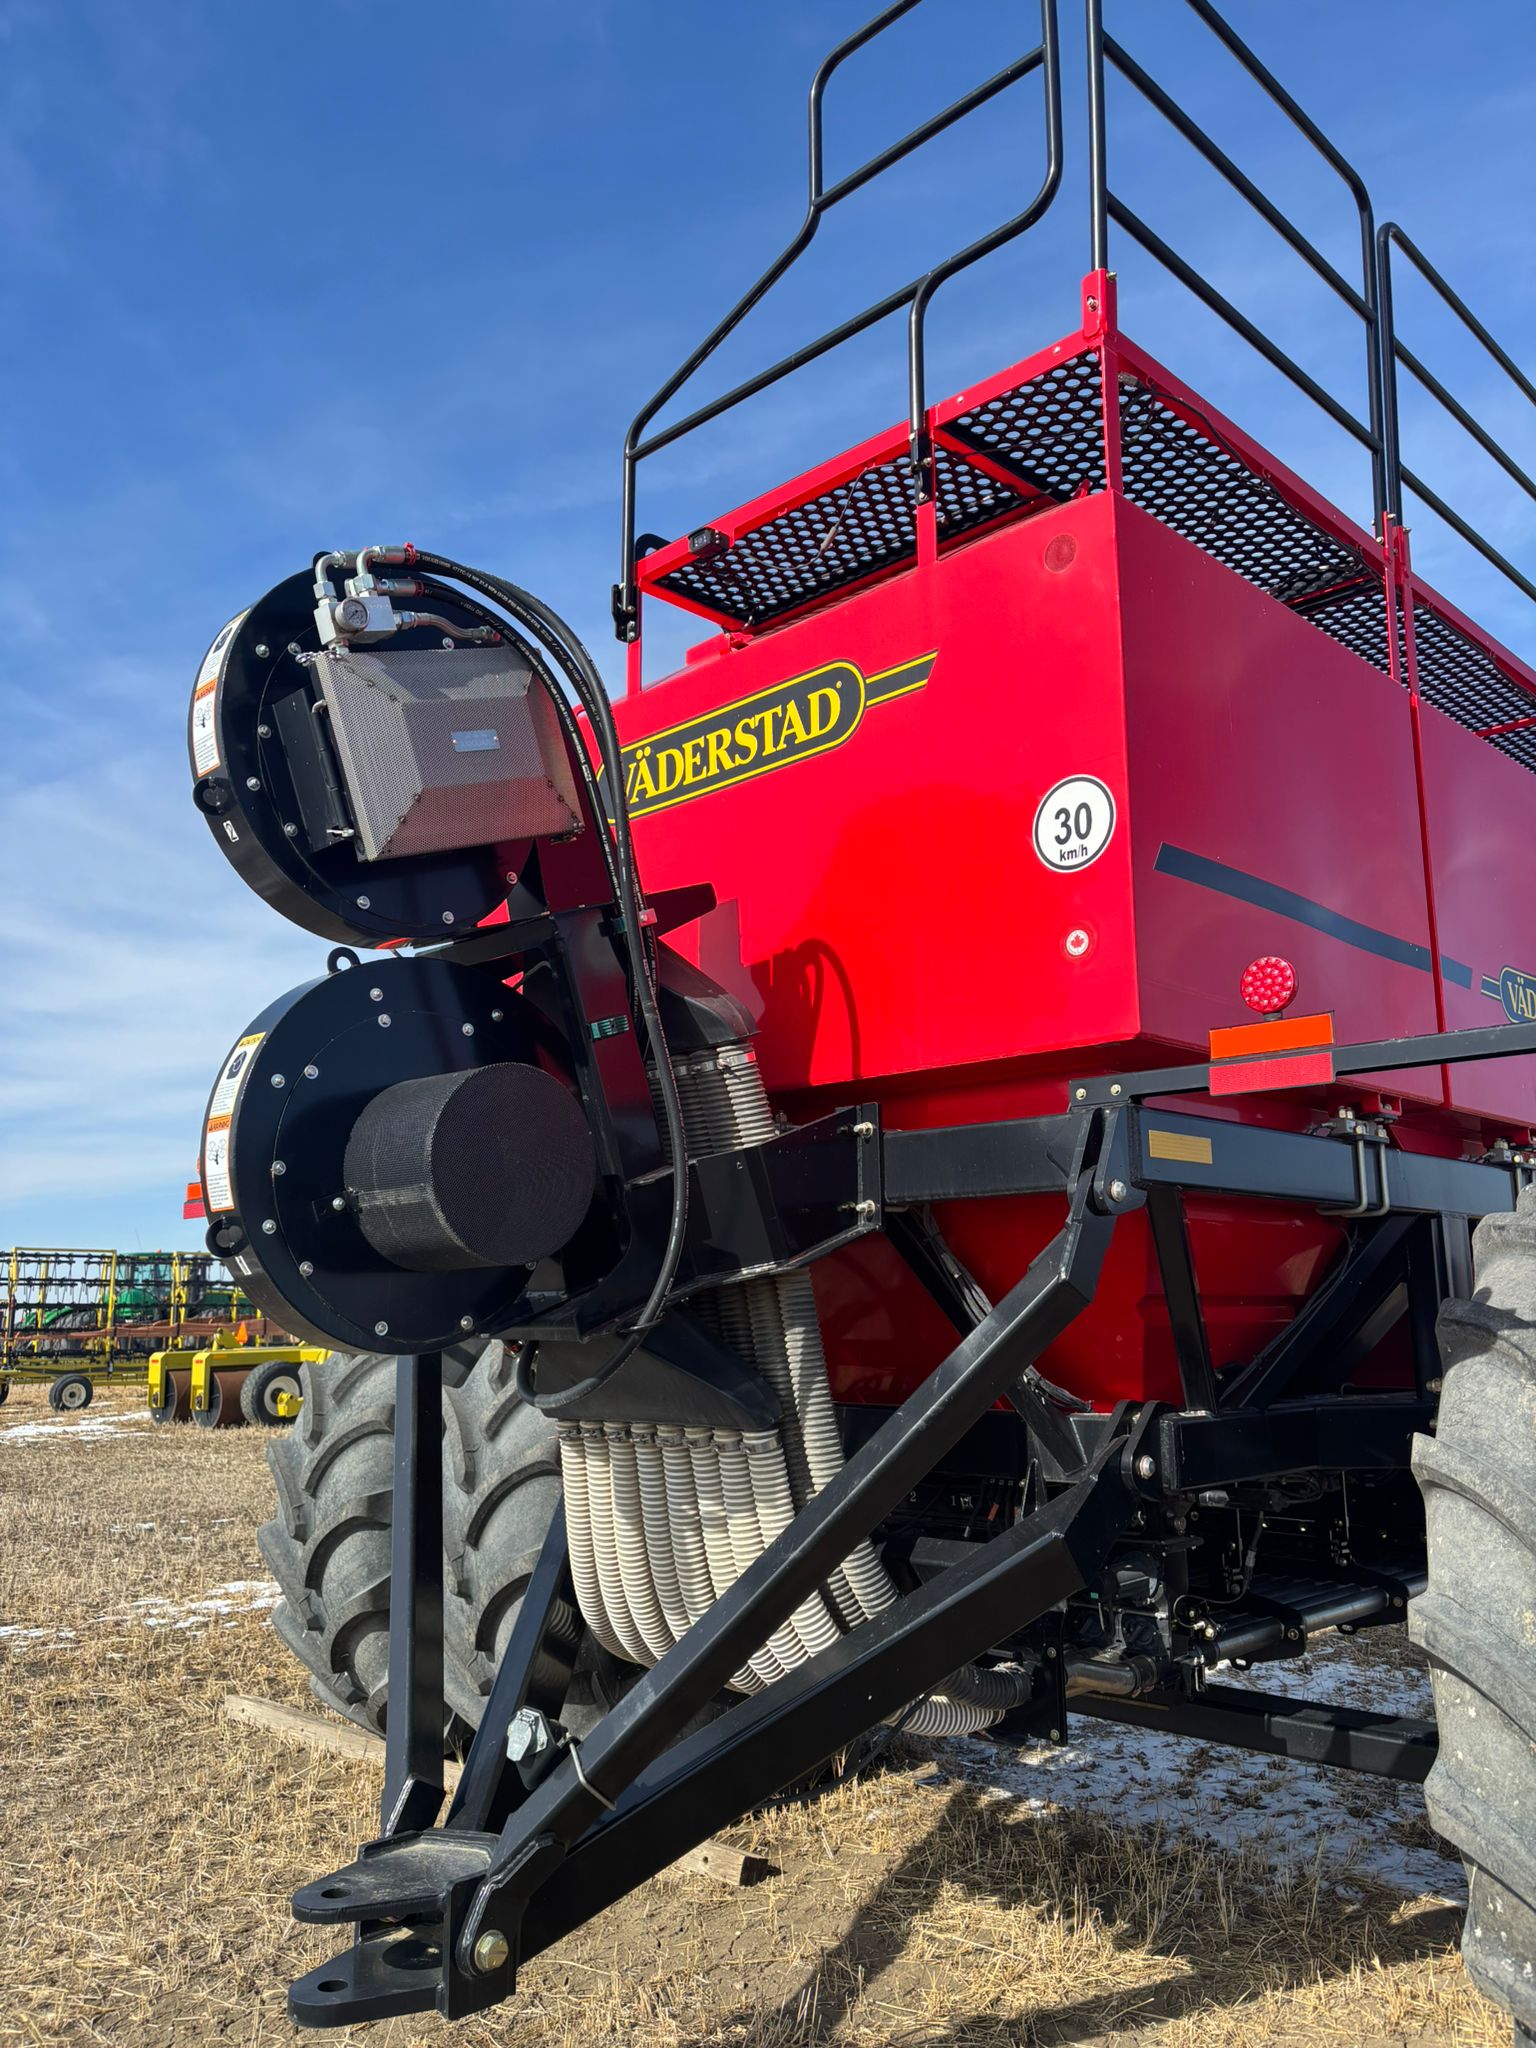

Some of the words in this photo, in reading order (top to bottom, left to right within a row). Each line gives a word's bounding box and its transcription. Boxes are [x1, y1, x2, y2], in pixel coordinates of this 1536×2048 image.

[1054, 802, 1093, 845] 30
[1059, 844, 1089, 862] km/h
[910, 1491, 917, 1502] 2
[952, 1495, 957, 1506] 1
